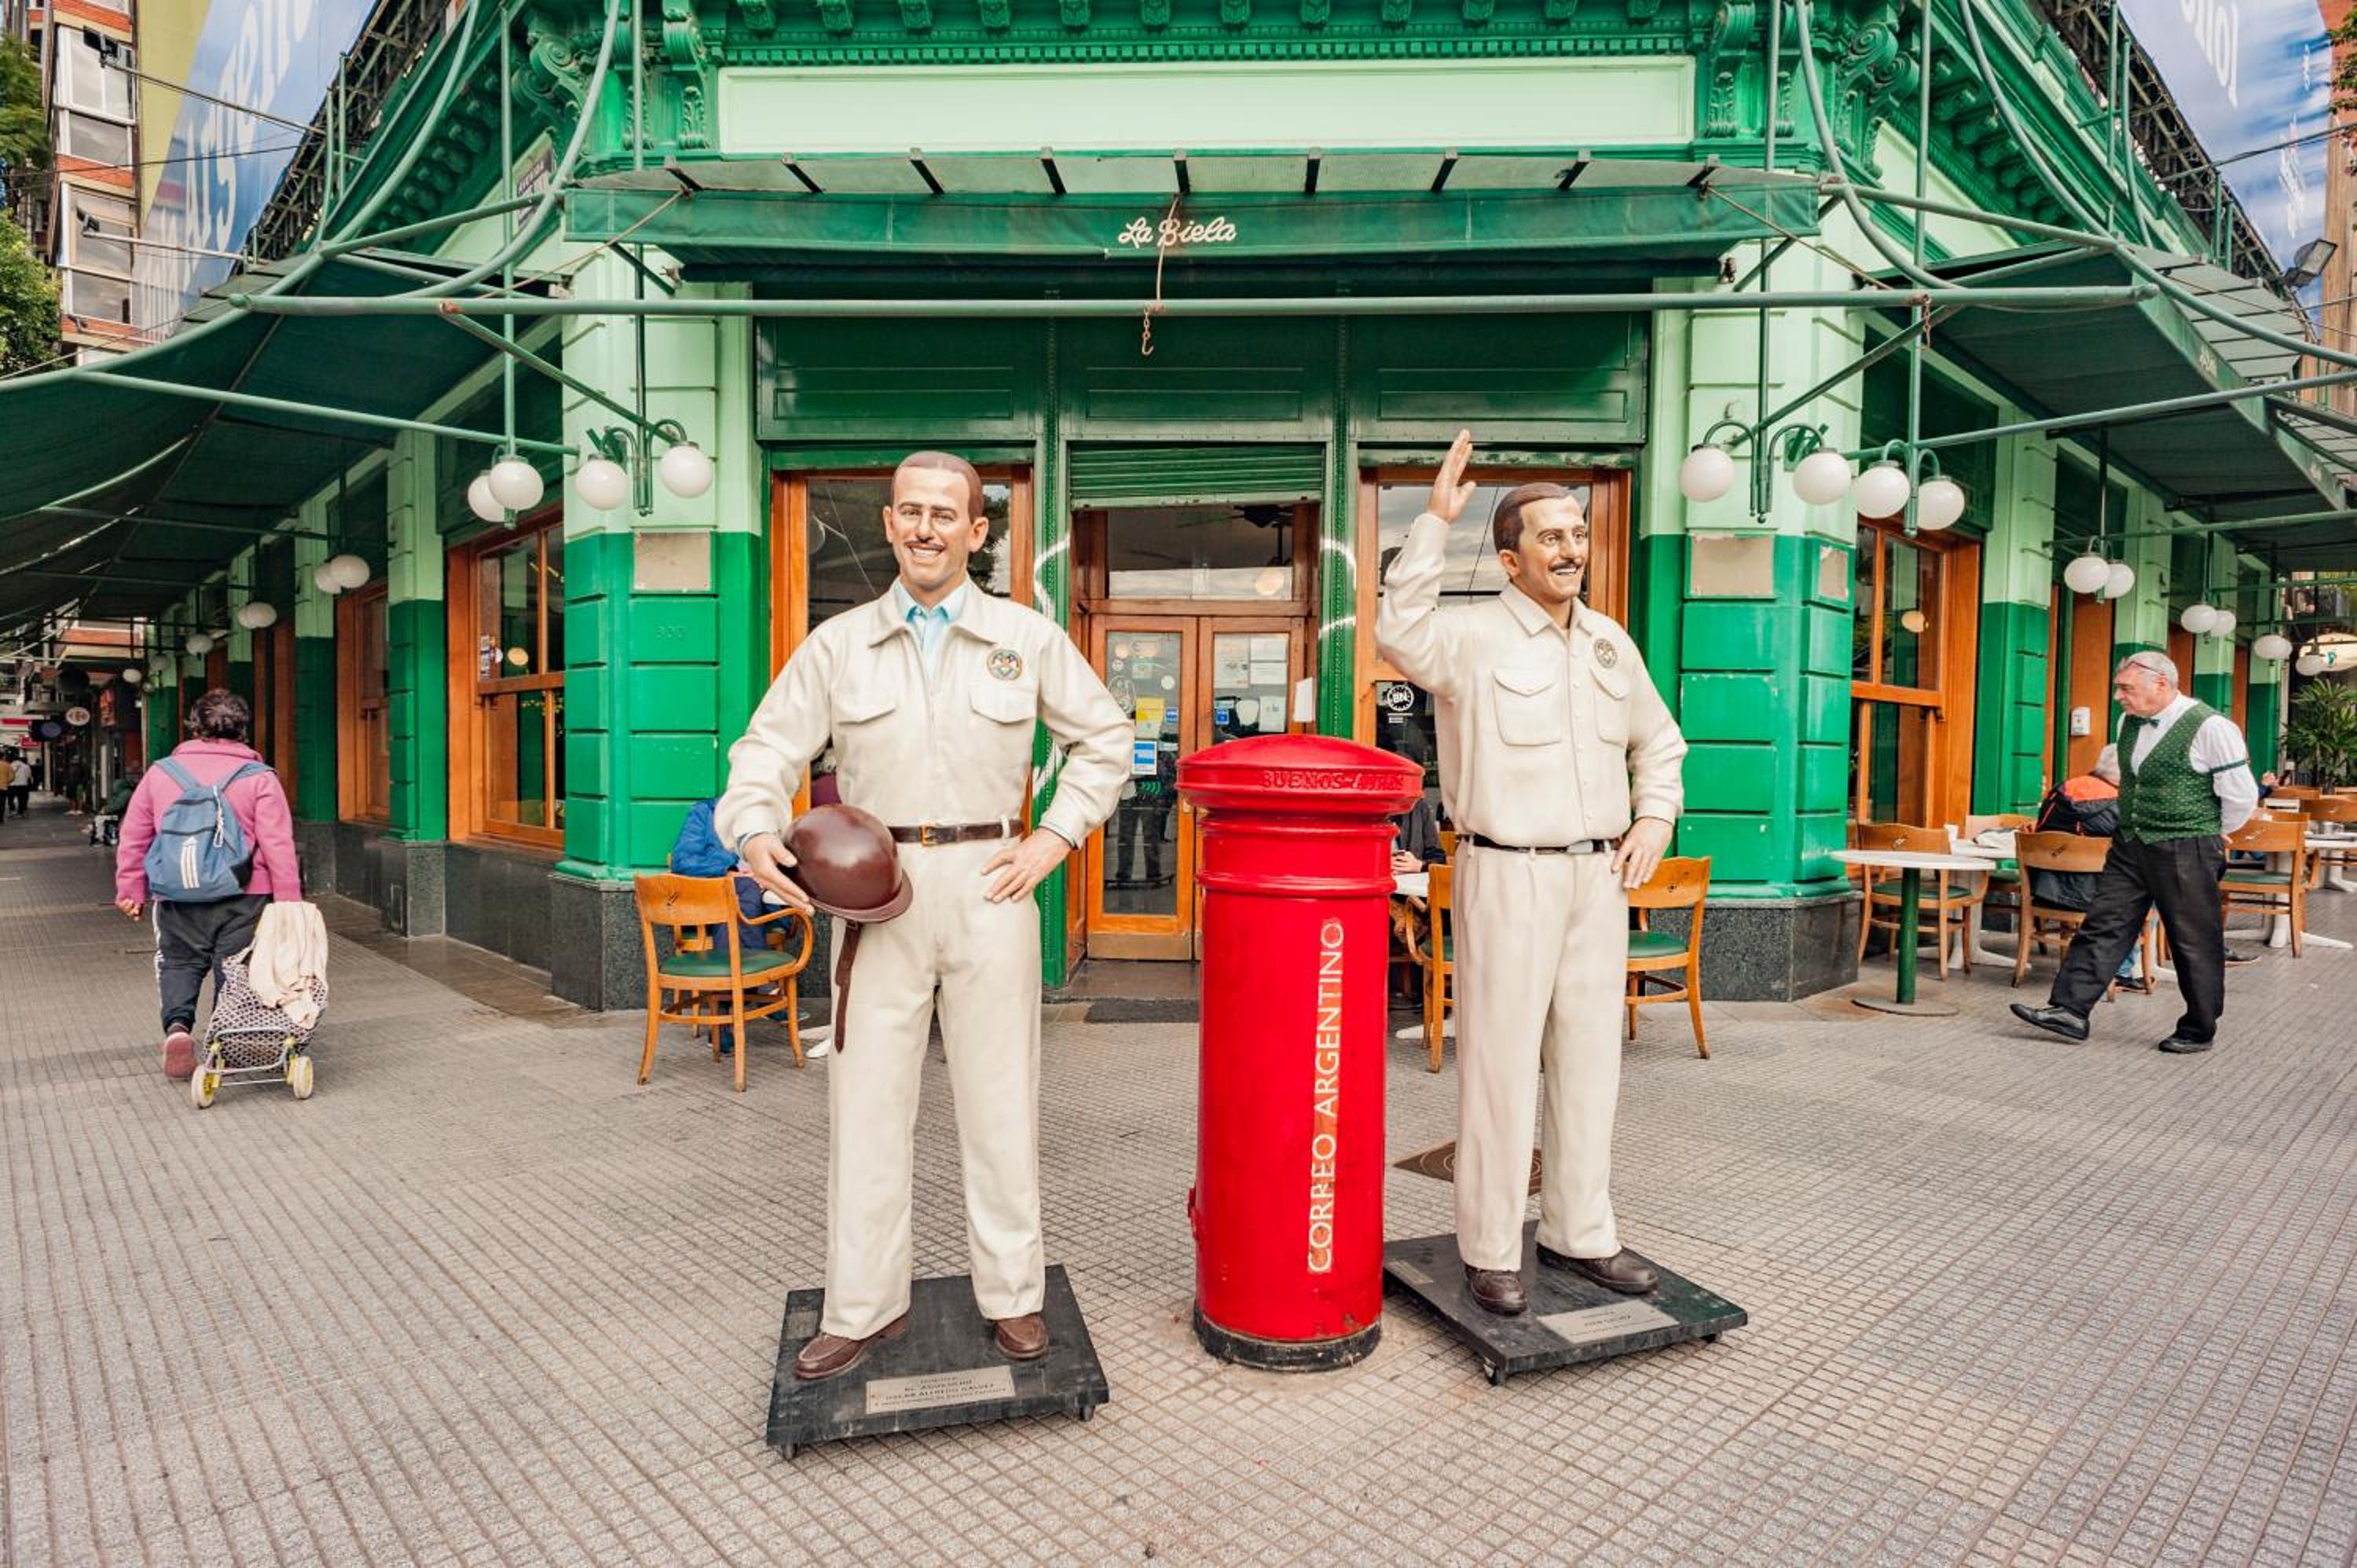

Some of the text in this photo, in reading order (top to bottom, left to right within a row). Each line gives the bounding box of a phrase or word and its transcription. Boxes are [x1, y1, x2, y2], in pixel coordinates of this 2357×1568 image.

[1119, 216, 1237, 249] La Biela
[1308, 922, 1344, 1272] CORREO ARGENTINO
